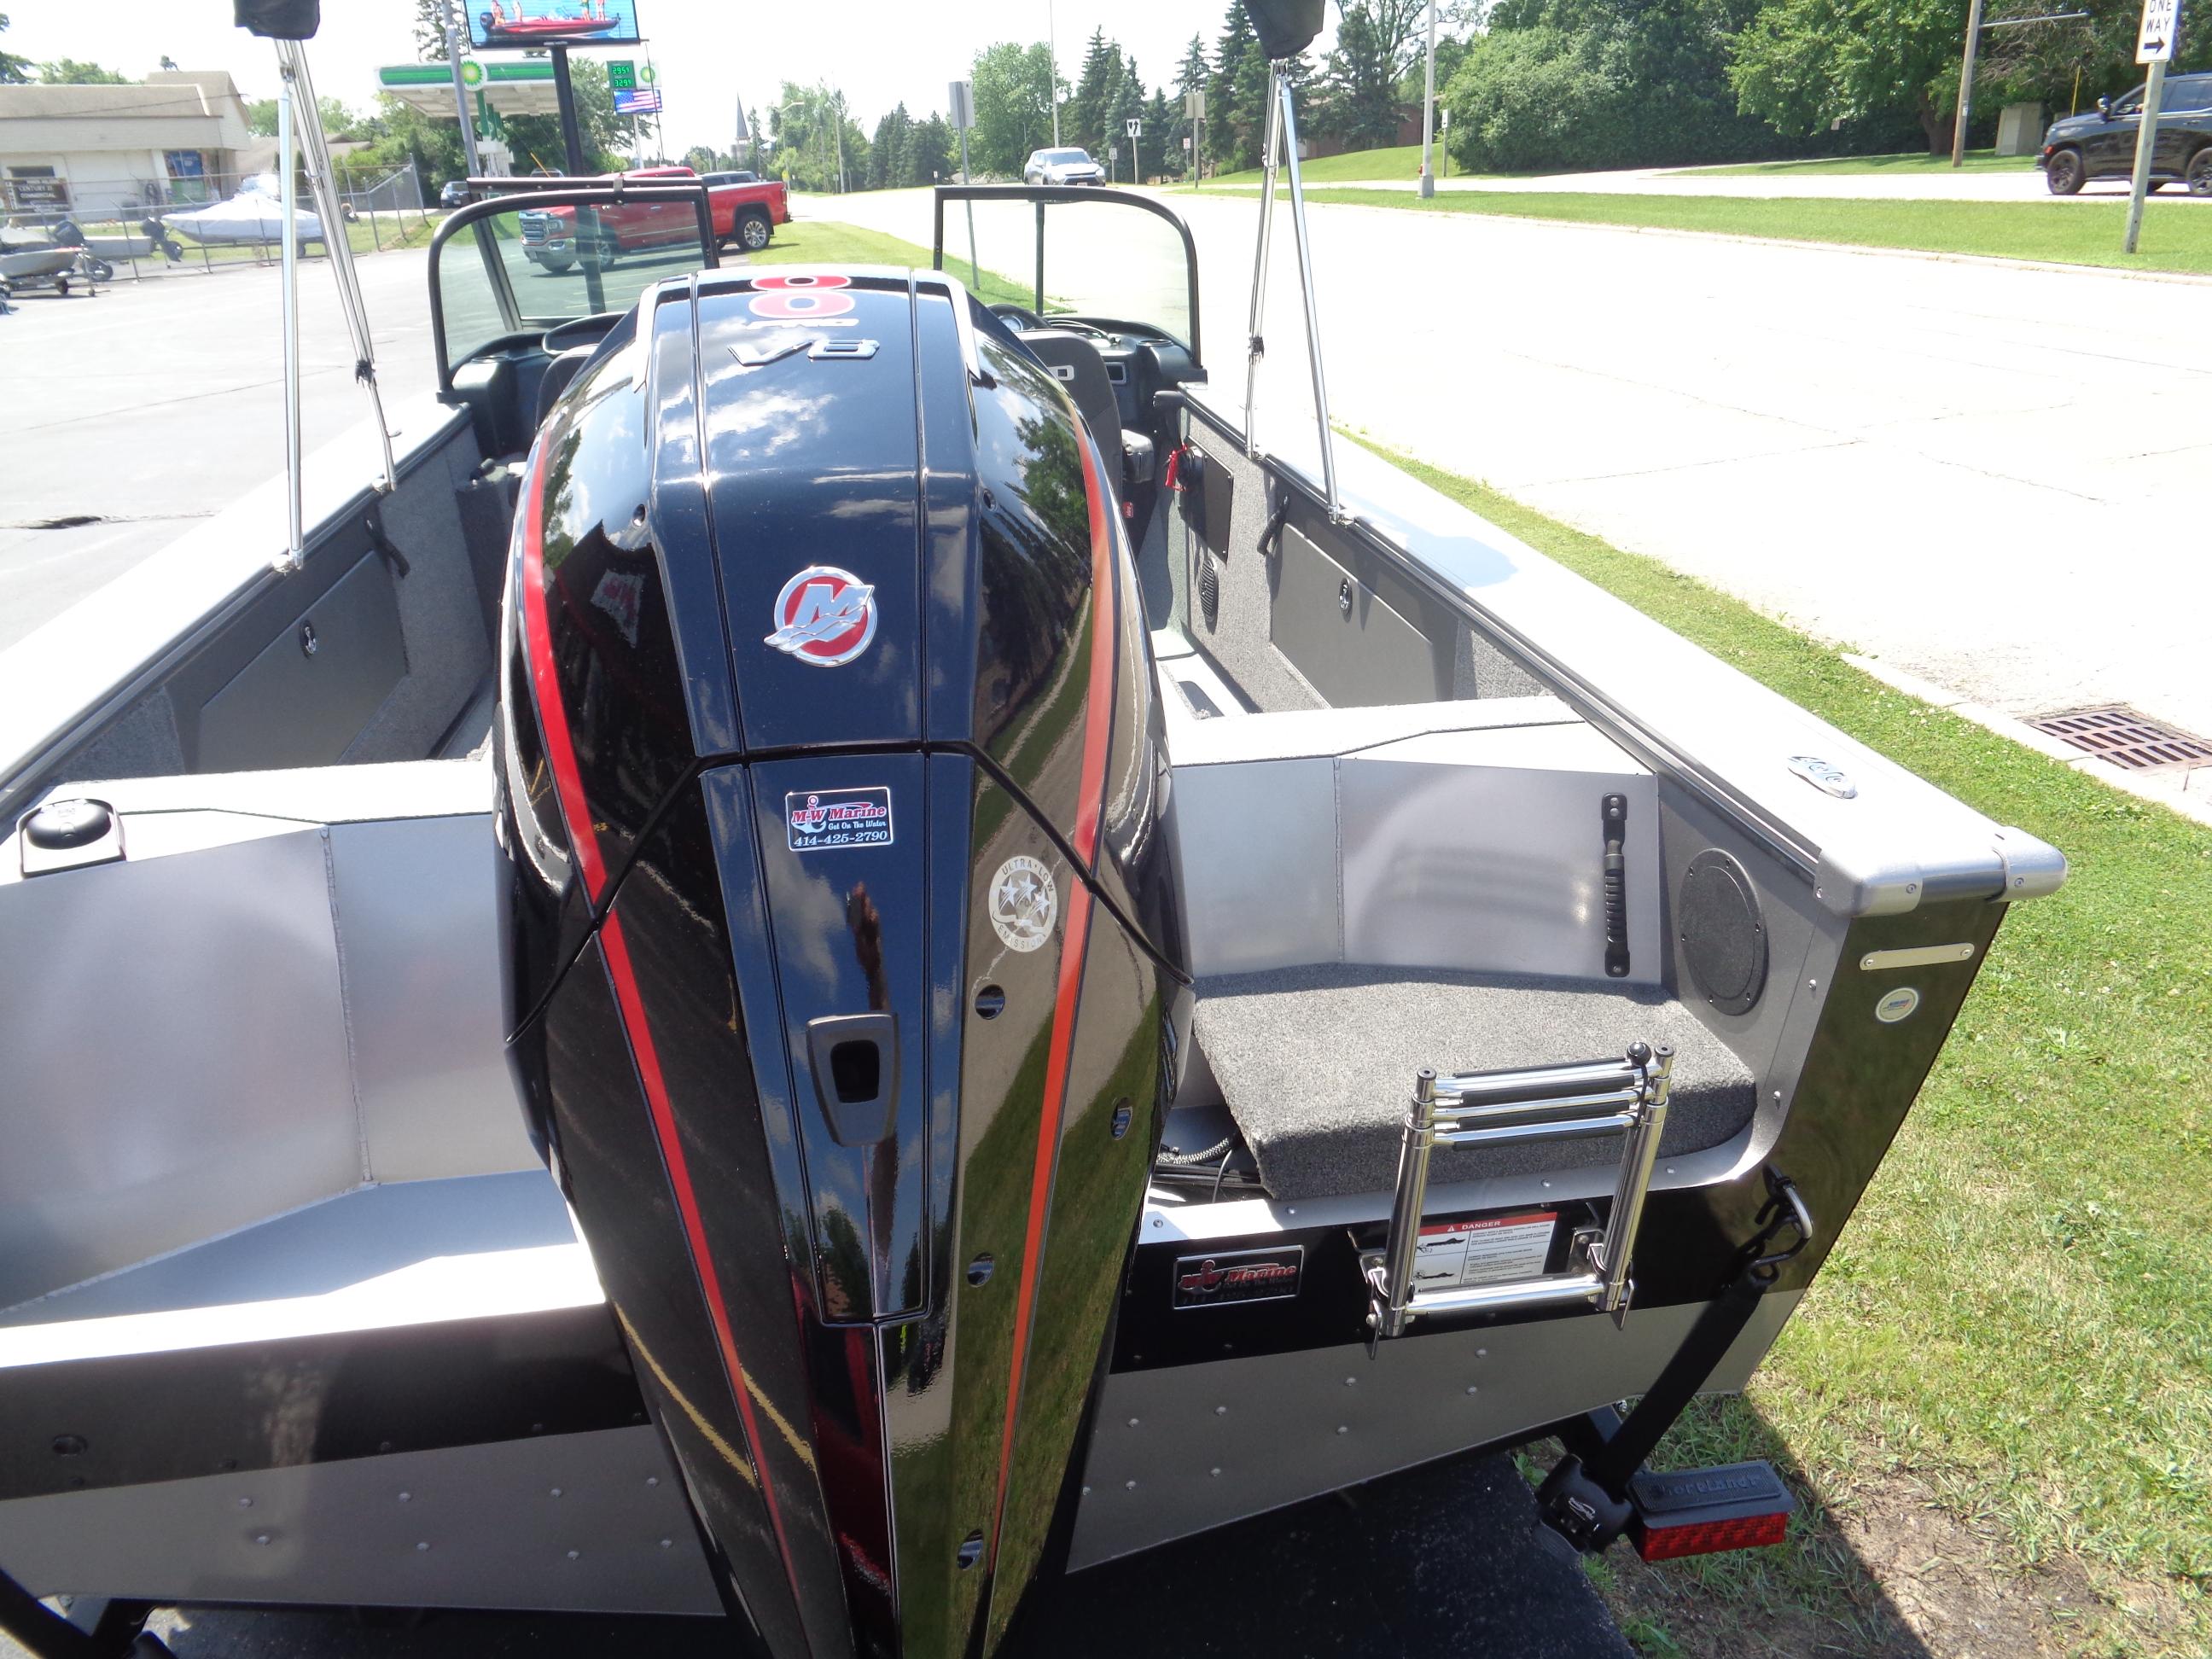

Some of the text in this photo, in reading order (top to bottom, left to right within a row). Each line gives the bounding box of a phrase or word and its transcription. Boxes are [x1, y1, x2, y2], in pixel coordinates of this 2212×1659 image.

[2150, 0, 2172, 13] ONE
[2146, 16, 2171, 32] WAY
[828, 806, 887, 821] Marine
[828, 821, 841, 831] Get
[866, 819, 887, 829] Water
[794, 830, 888, 847] 414-425-2790
[1461, 1220, 1502, 1231] DANGER
[1224, 1265, 1298, 1284] Marine
